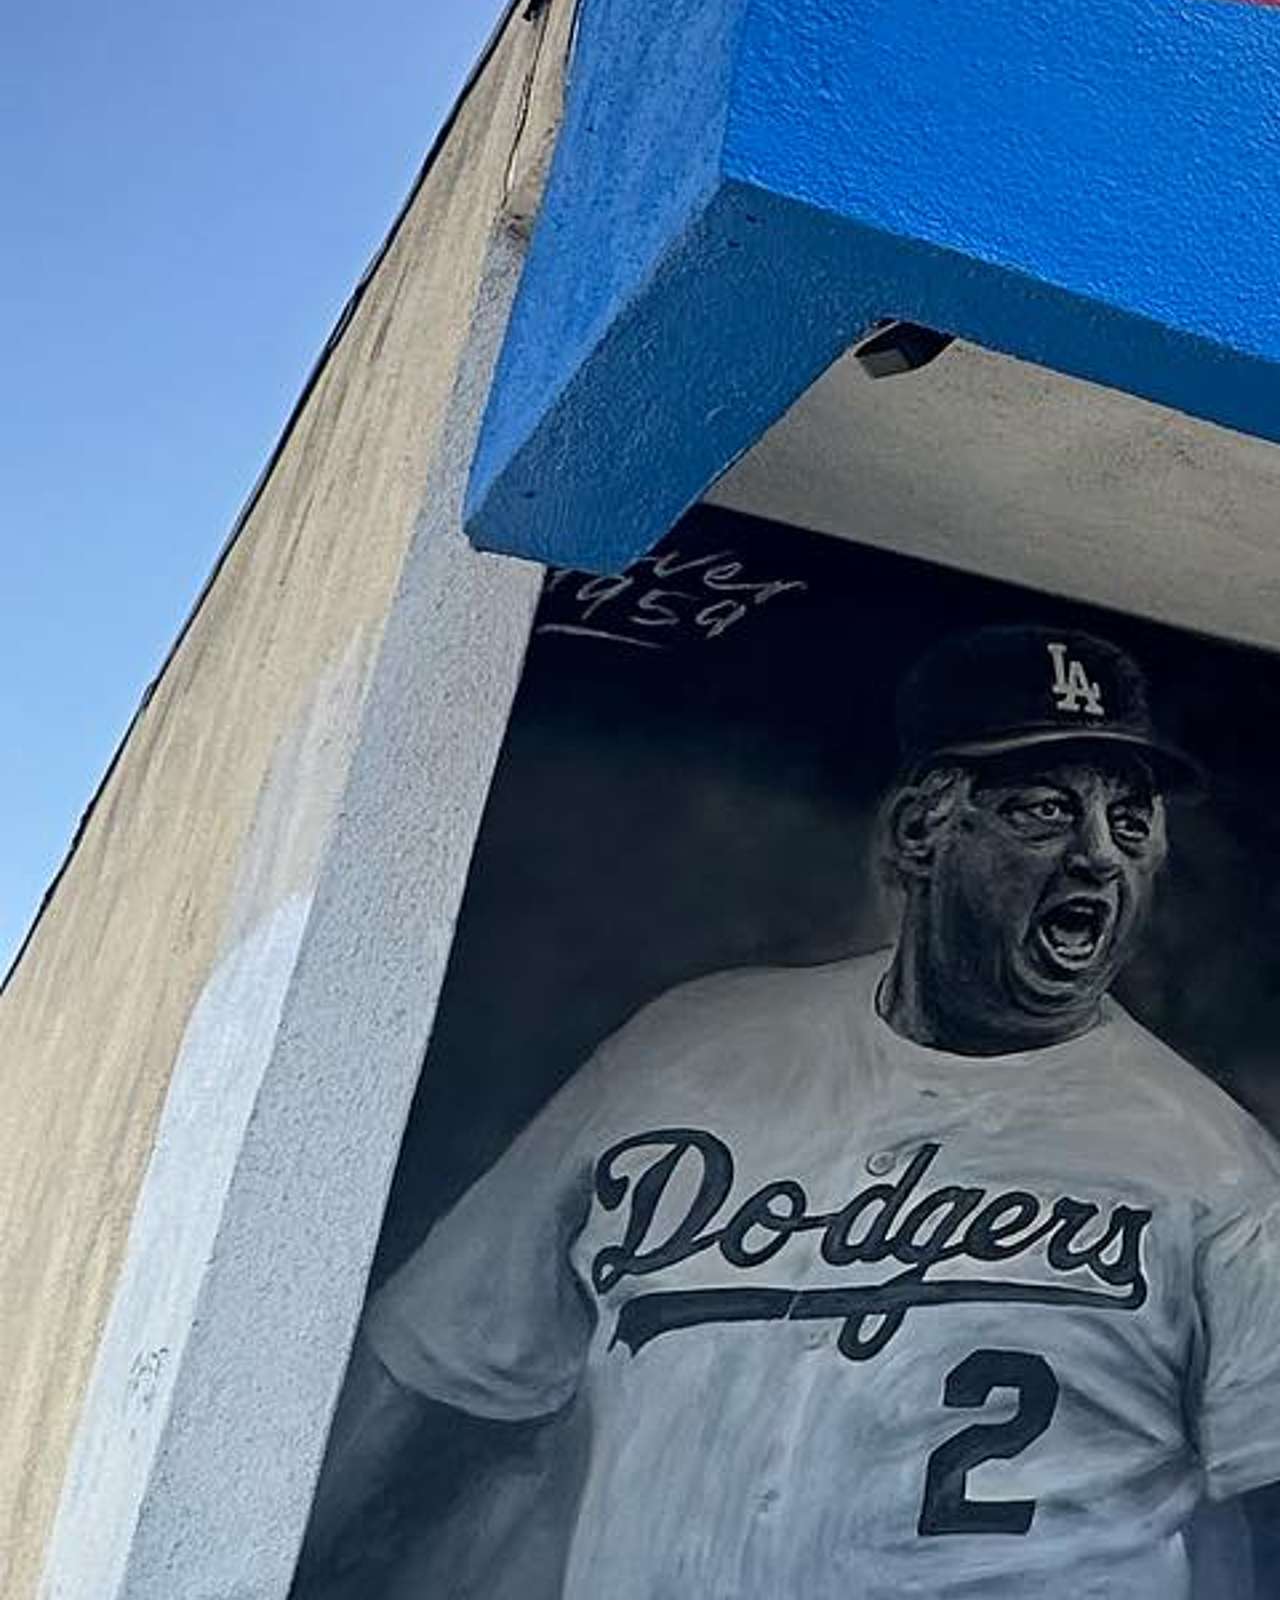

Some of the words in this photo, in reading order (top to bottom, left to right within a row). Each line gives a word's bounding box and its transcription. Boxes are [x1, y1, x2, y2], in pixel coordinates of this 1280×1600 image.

[1045, 643, 1106, 717] LA
[593, 1128, 1151, 1361] Dodgers
[916, 1348, 1061, 1538] 2
